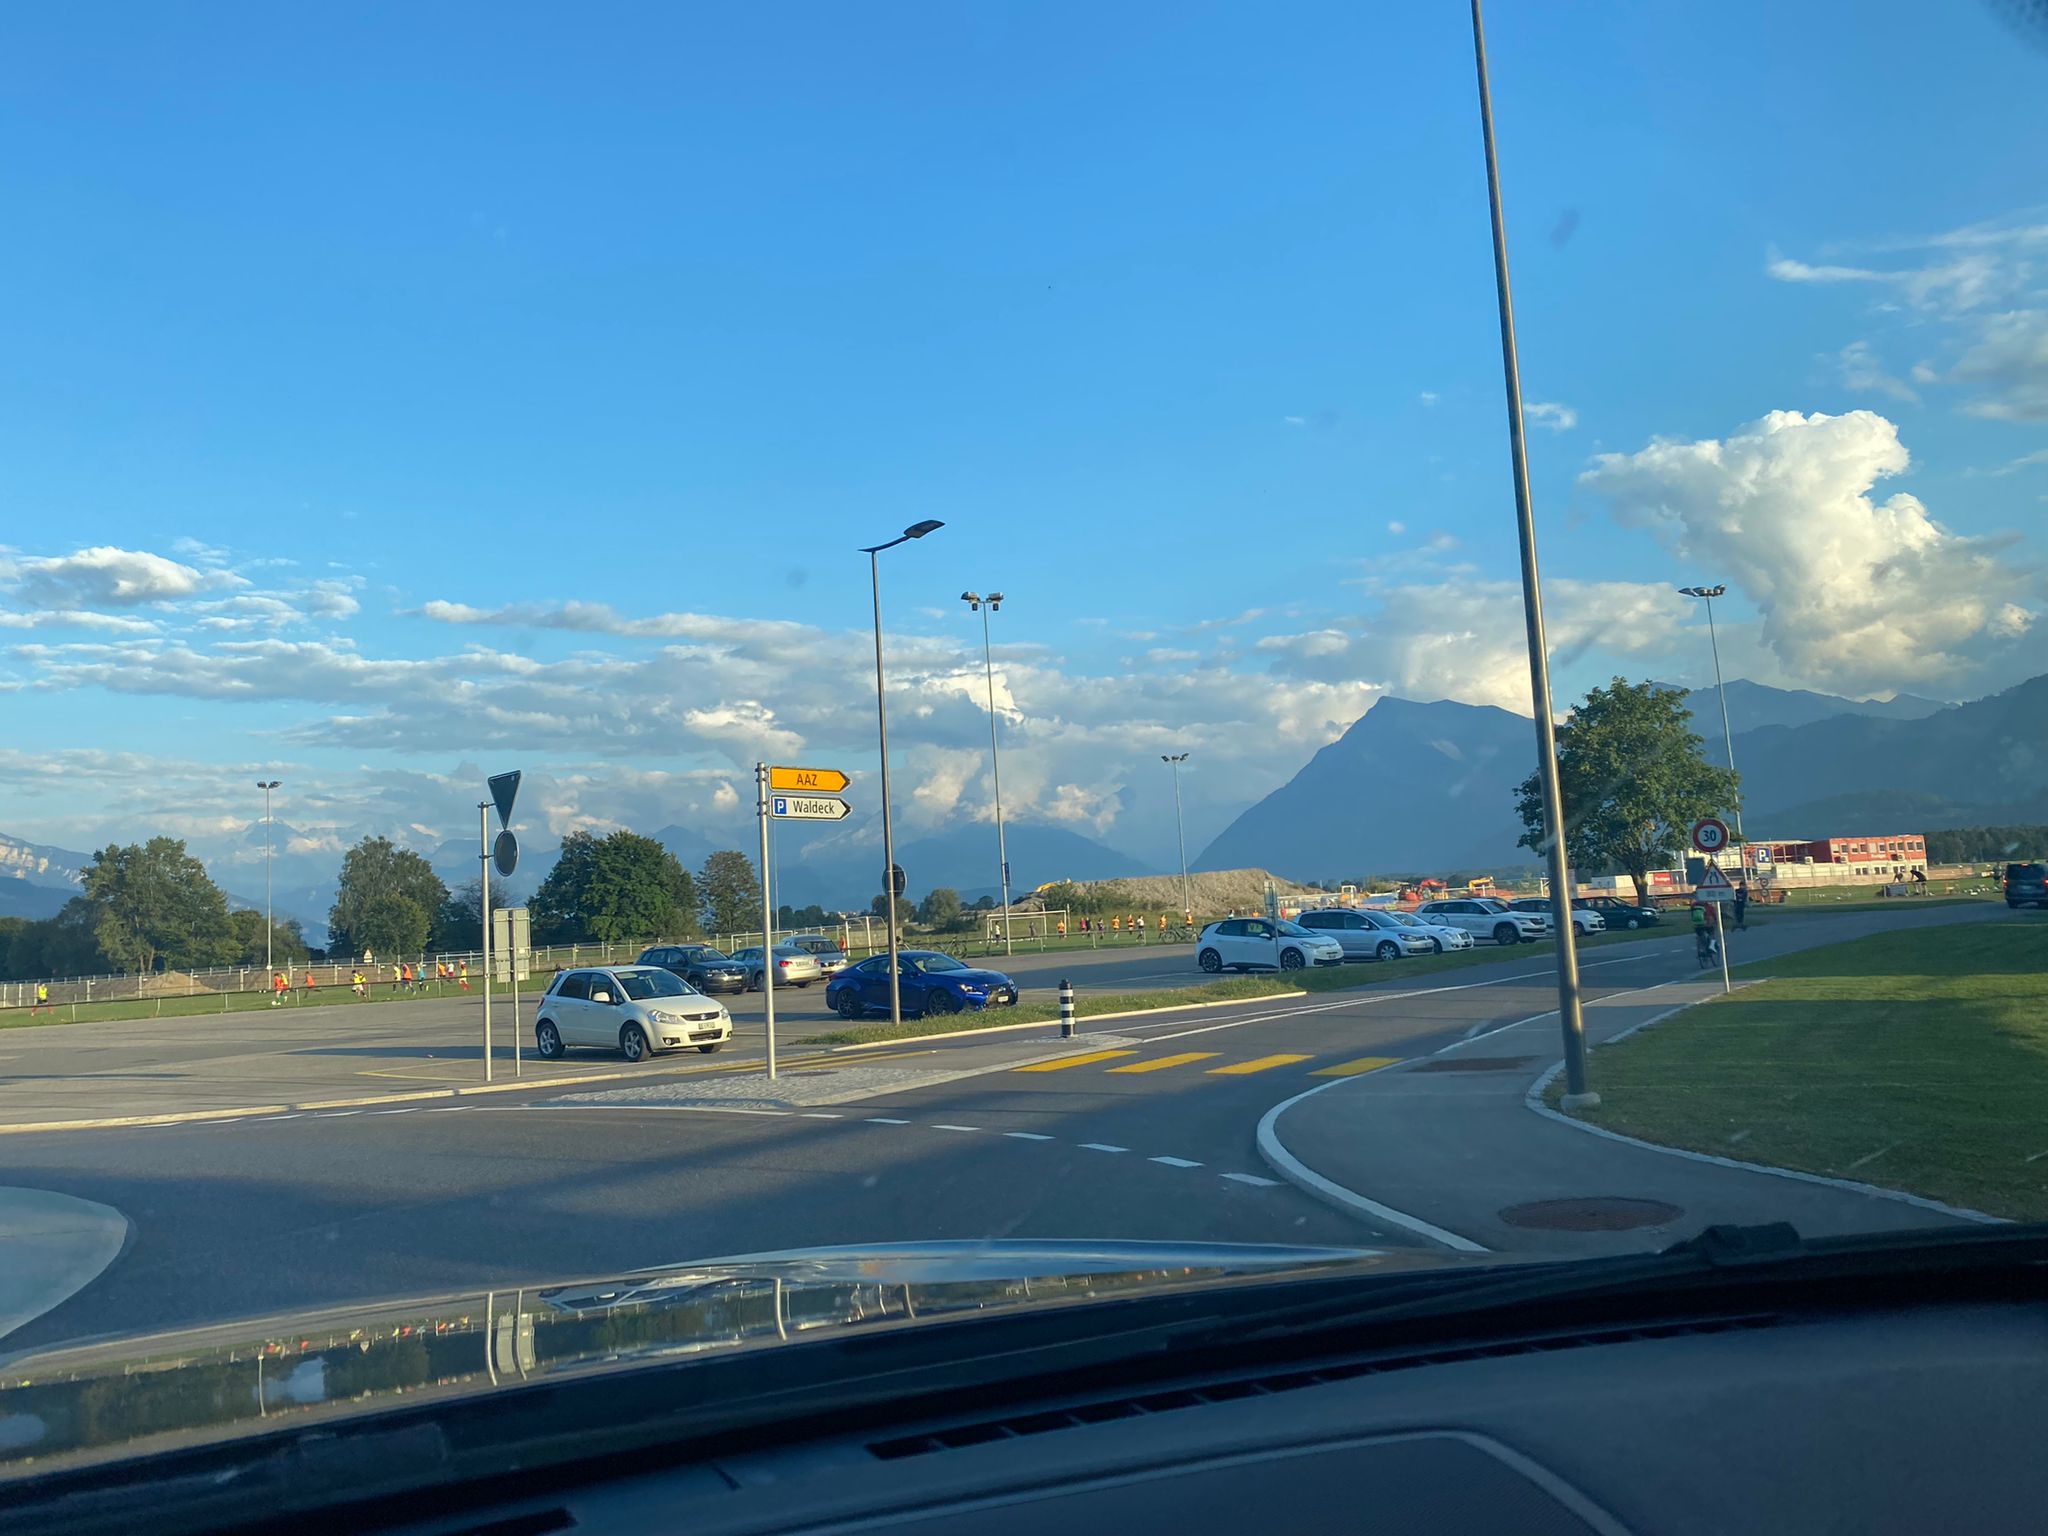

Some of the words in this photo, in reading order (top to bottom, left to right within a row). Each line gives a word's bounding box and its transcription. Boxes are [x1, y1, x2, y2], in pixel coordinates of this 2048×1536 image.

[796, 773, 818, 786] AAZ
[777, 800, 785, 813] P
[793, 801, 835, 814] Waldeck
[1703, 830, 1717, 842] 30
[1759, 849, 1767, 861] P
